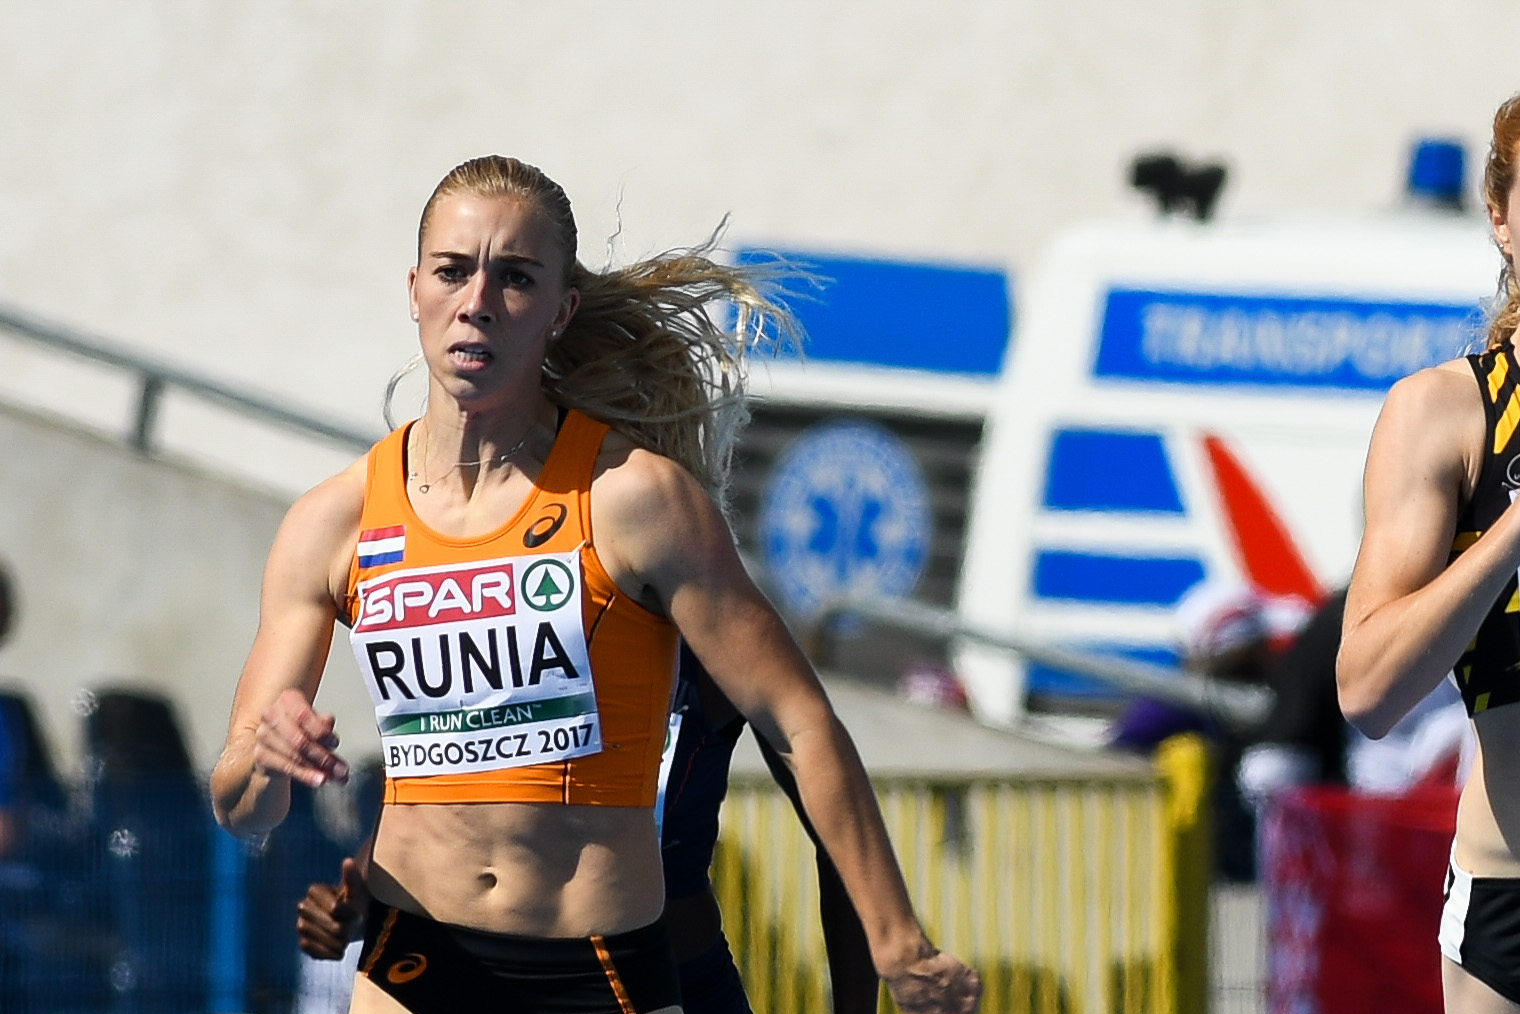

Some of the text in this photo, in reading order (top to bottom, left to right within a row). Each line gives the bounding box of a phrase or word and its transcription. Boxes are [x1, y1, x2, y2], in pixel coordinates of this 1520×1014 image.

[360, 572, 513, 626] SPAR
[365, 620, 580, 700] RUNIA
[389, 722, 594, 768] BYDGOSZCZ 2017
[420, 716, 426, 732] I
[430, 713, 463, 732] RUN
